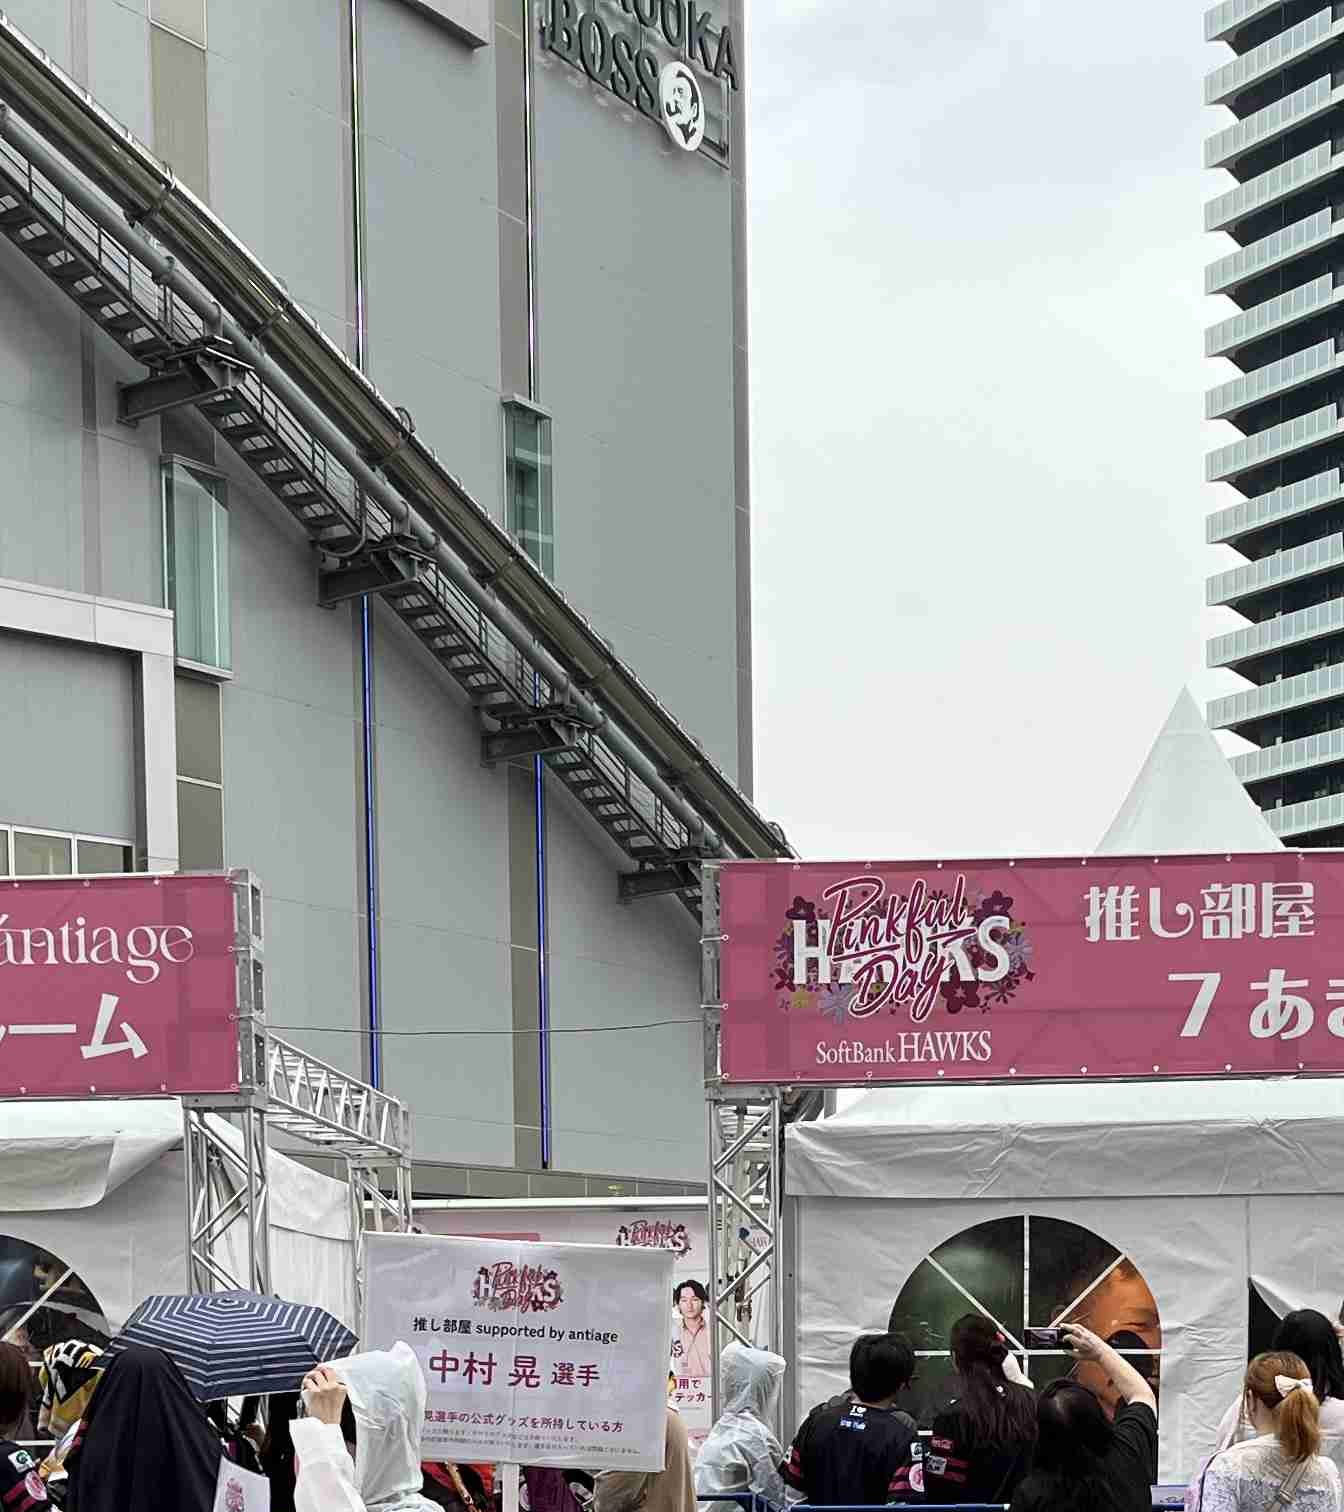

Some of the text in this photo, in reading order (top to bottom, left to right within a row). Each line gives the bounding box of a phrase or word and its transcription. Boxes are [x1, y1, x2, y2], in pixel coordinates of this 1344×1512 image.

[1083, 881, 1316, 942] 推し部屋
[816, 1030, 992, 1064] SoftBank HAWKS
[413, 1317, 619, 1344] 推し部屋 supported by antiage
[429, 1349, 600, 1388] 中村 晃 選手
